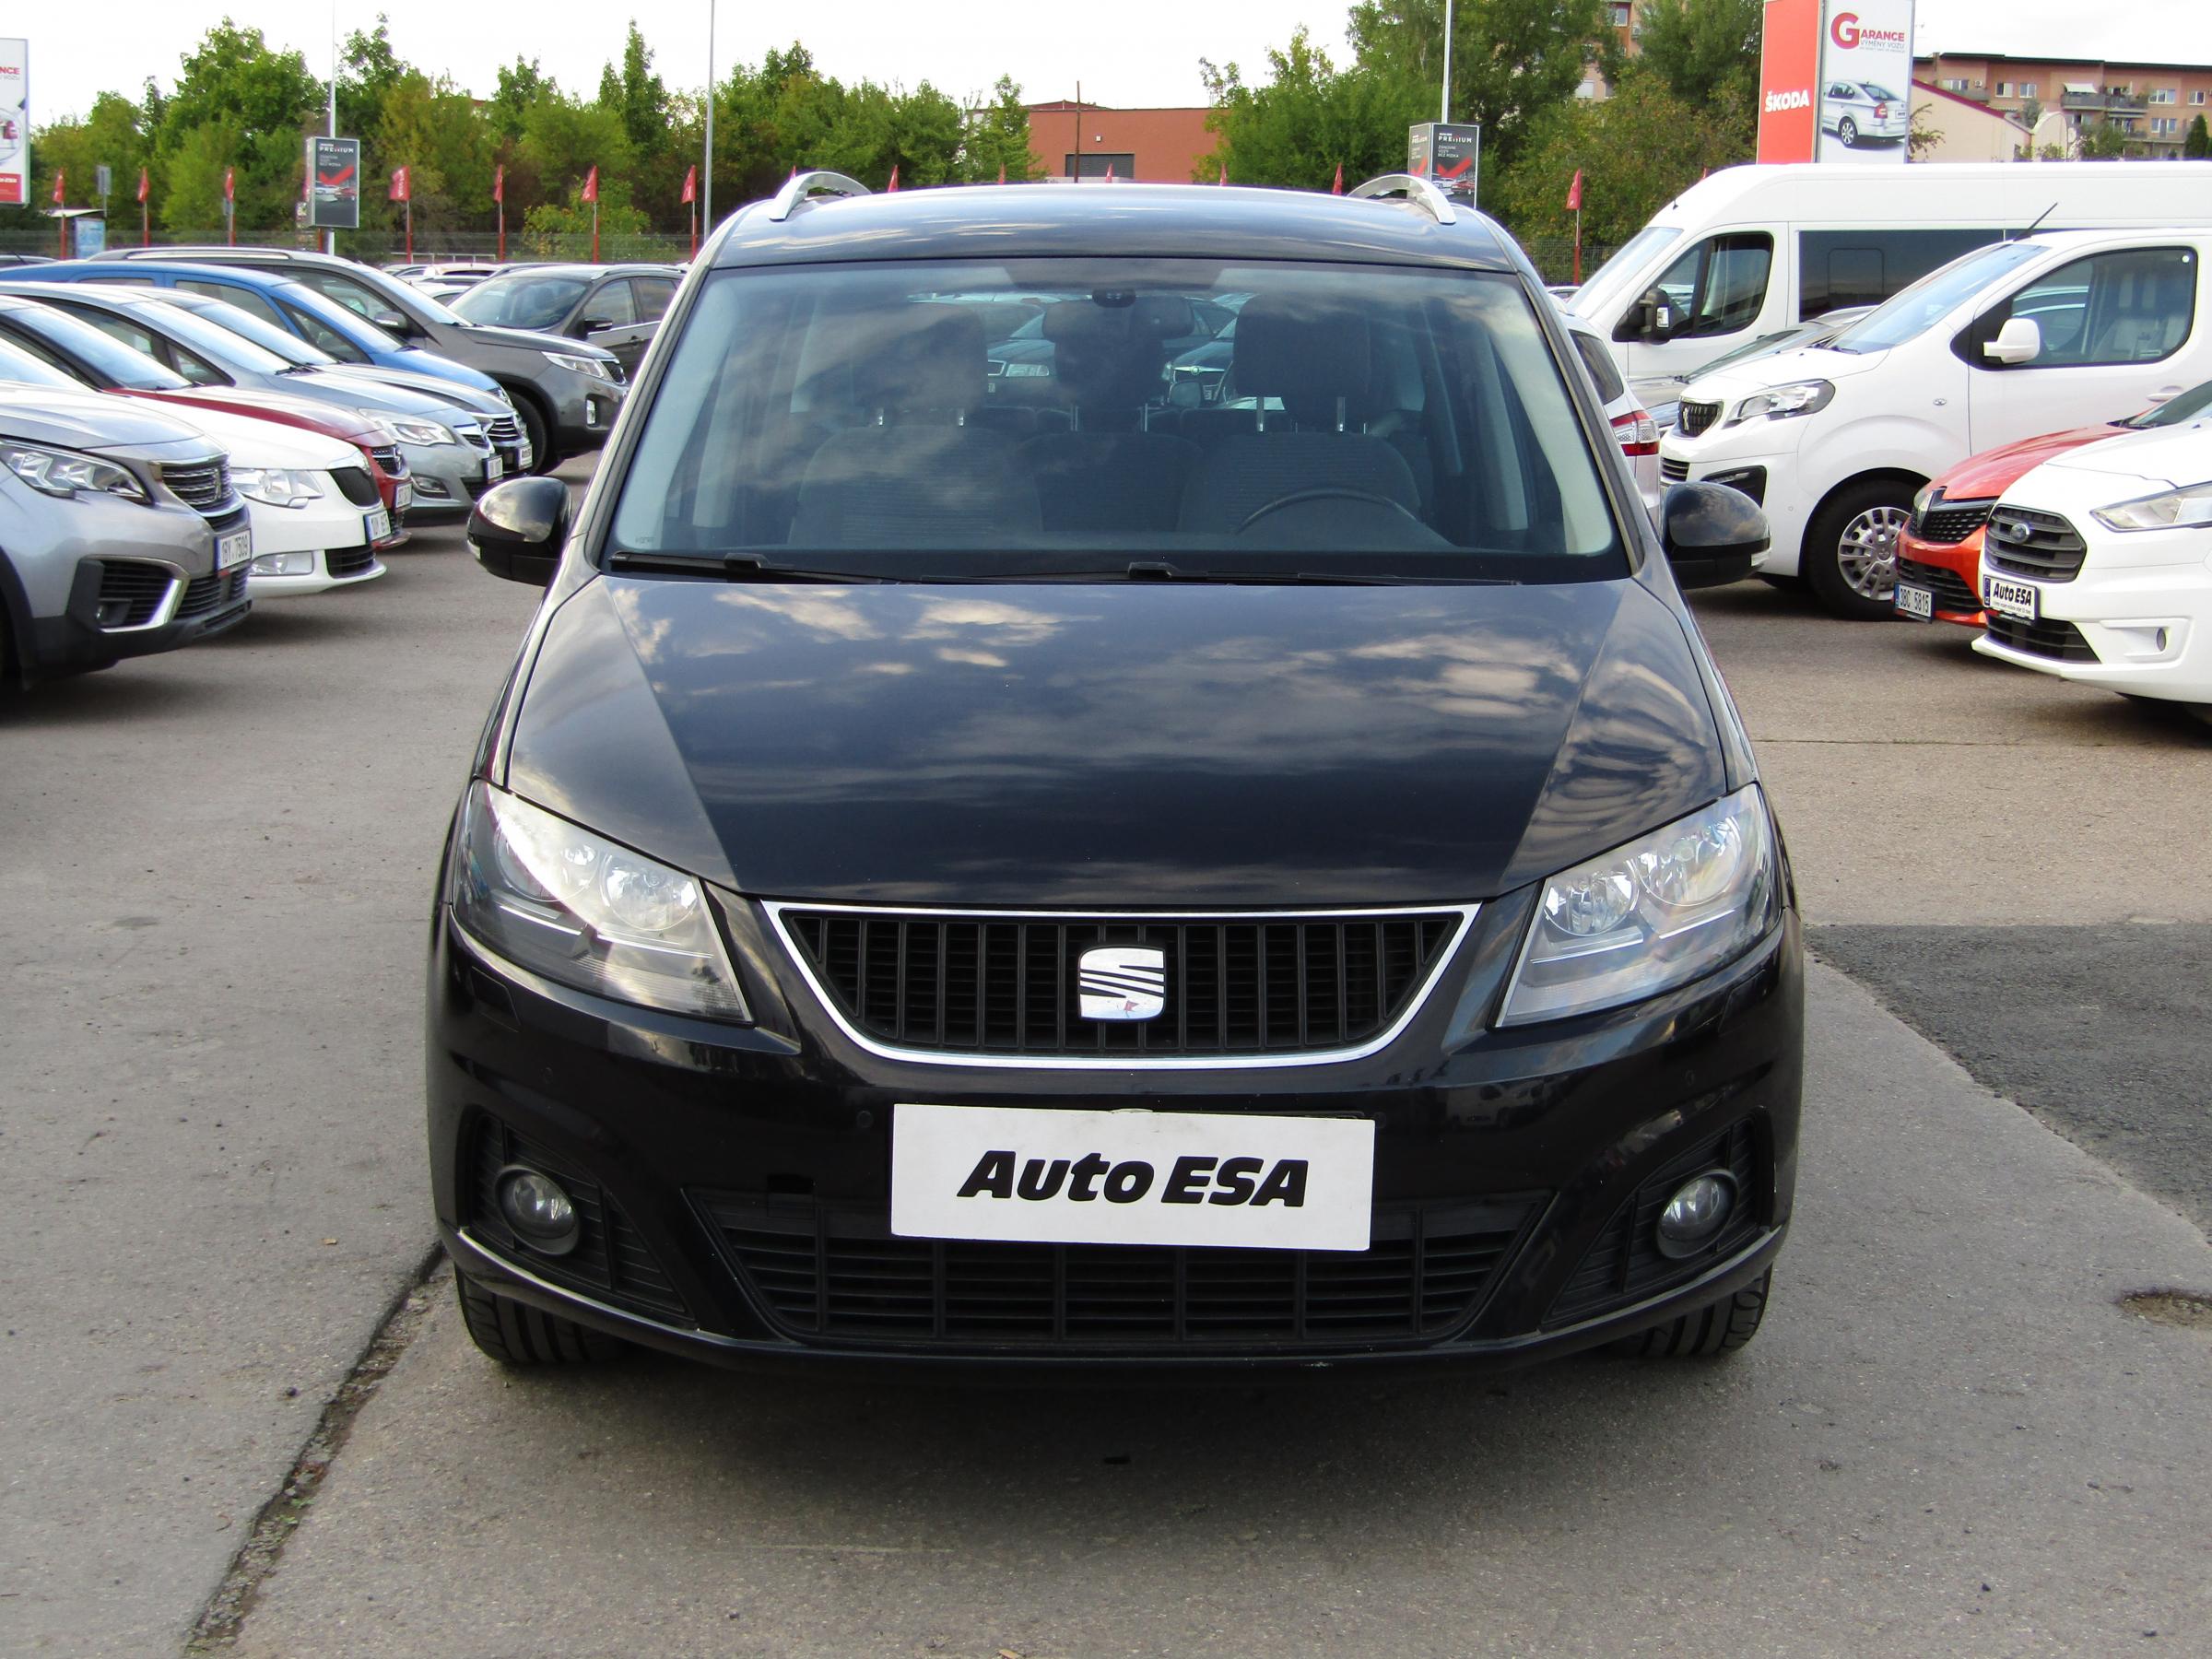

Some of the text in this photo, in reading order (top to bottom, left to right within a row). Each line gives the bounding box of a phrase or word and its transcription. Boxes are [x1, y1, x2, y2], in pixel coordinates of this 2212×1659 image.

[1830, 12, 1904, 49] GARANCE
[1765, 89, 1809, 112] ŠKODA
[1993, 582, 2014, 602] Auto
[2015, 588, 2032, 606] ESA
[957, 1149, 1309, 1208] Auto ESA
